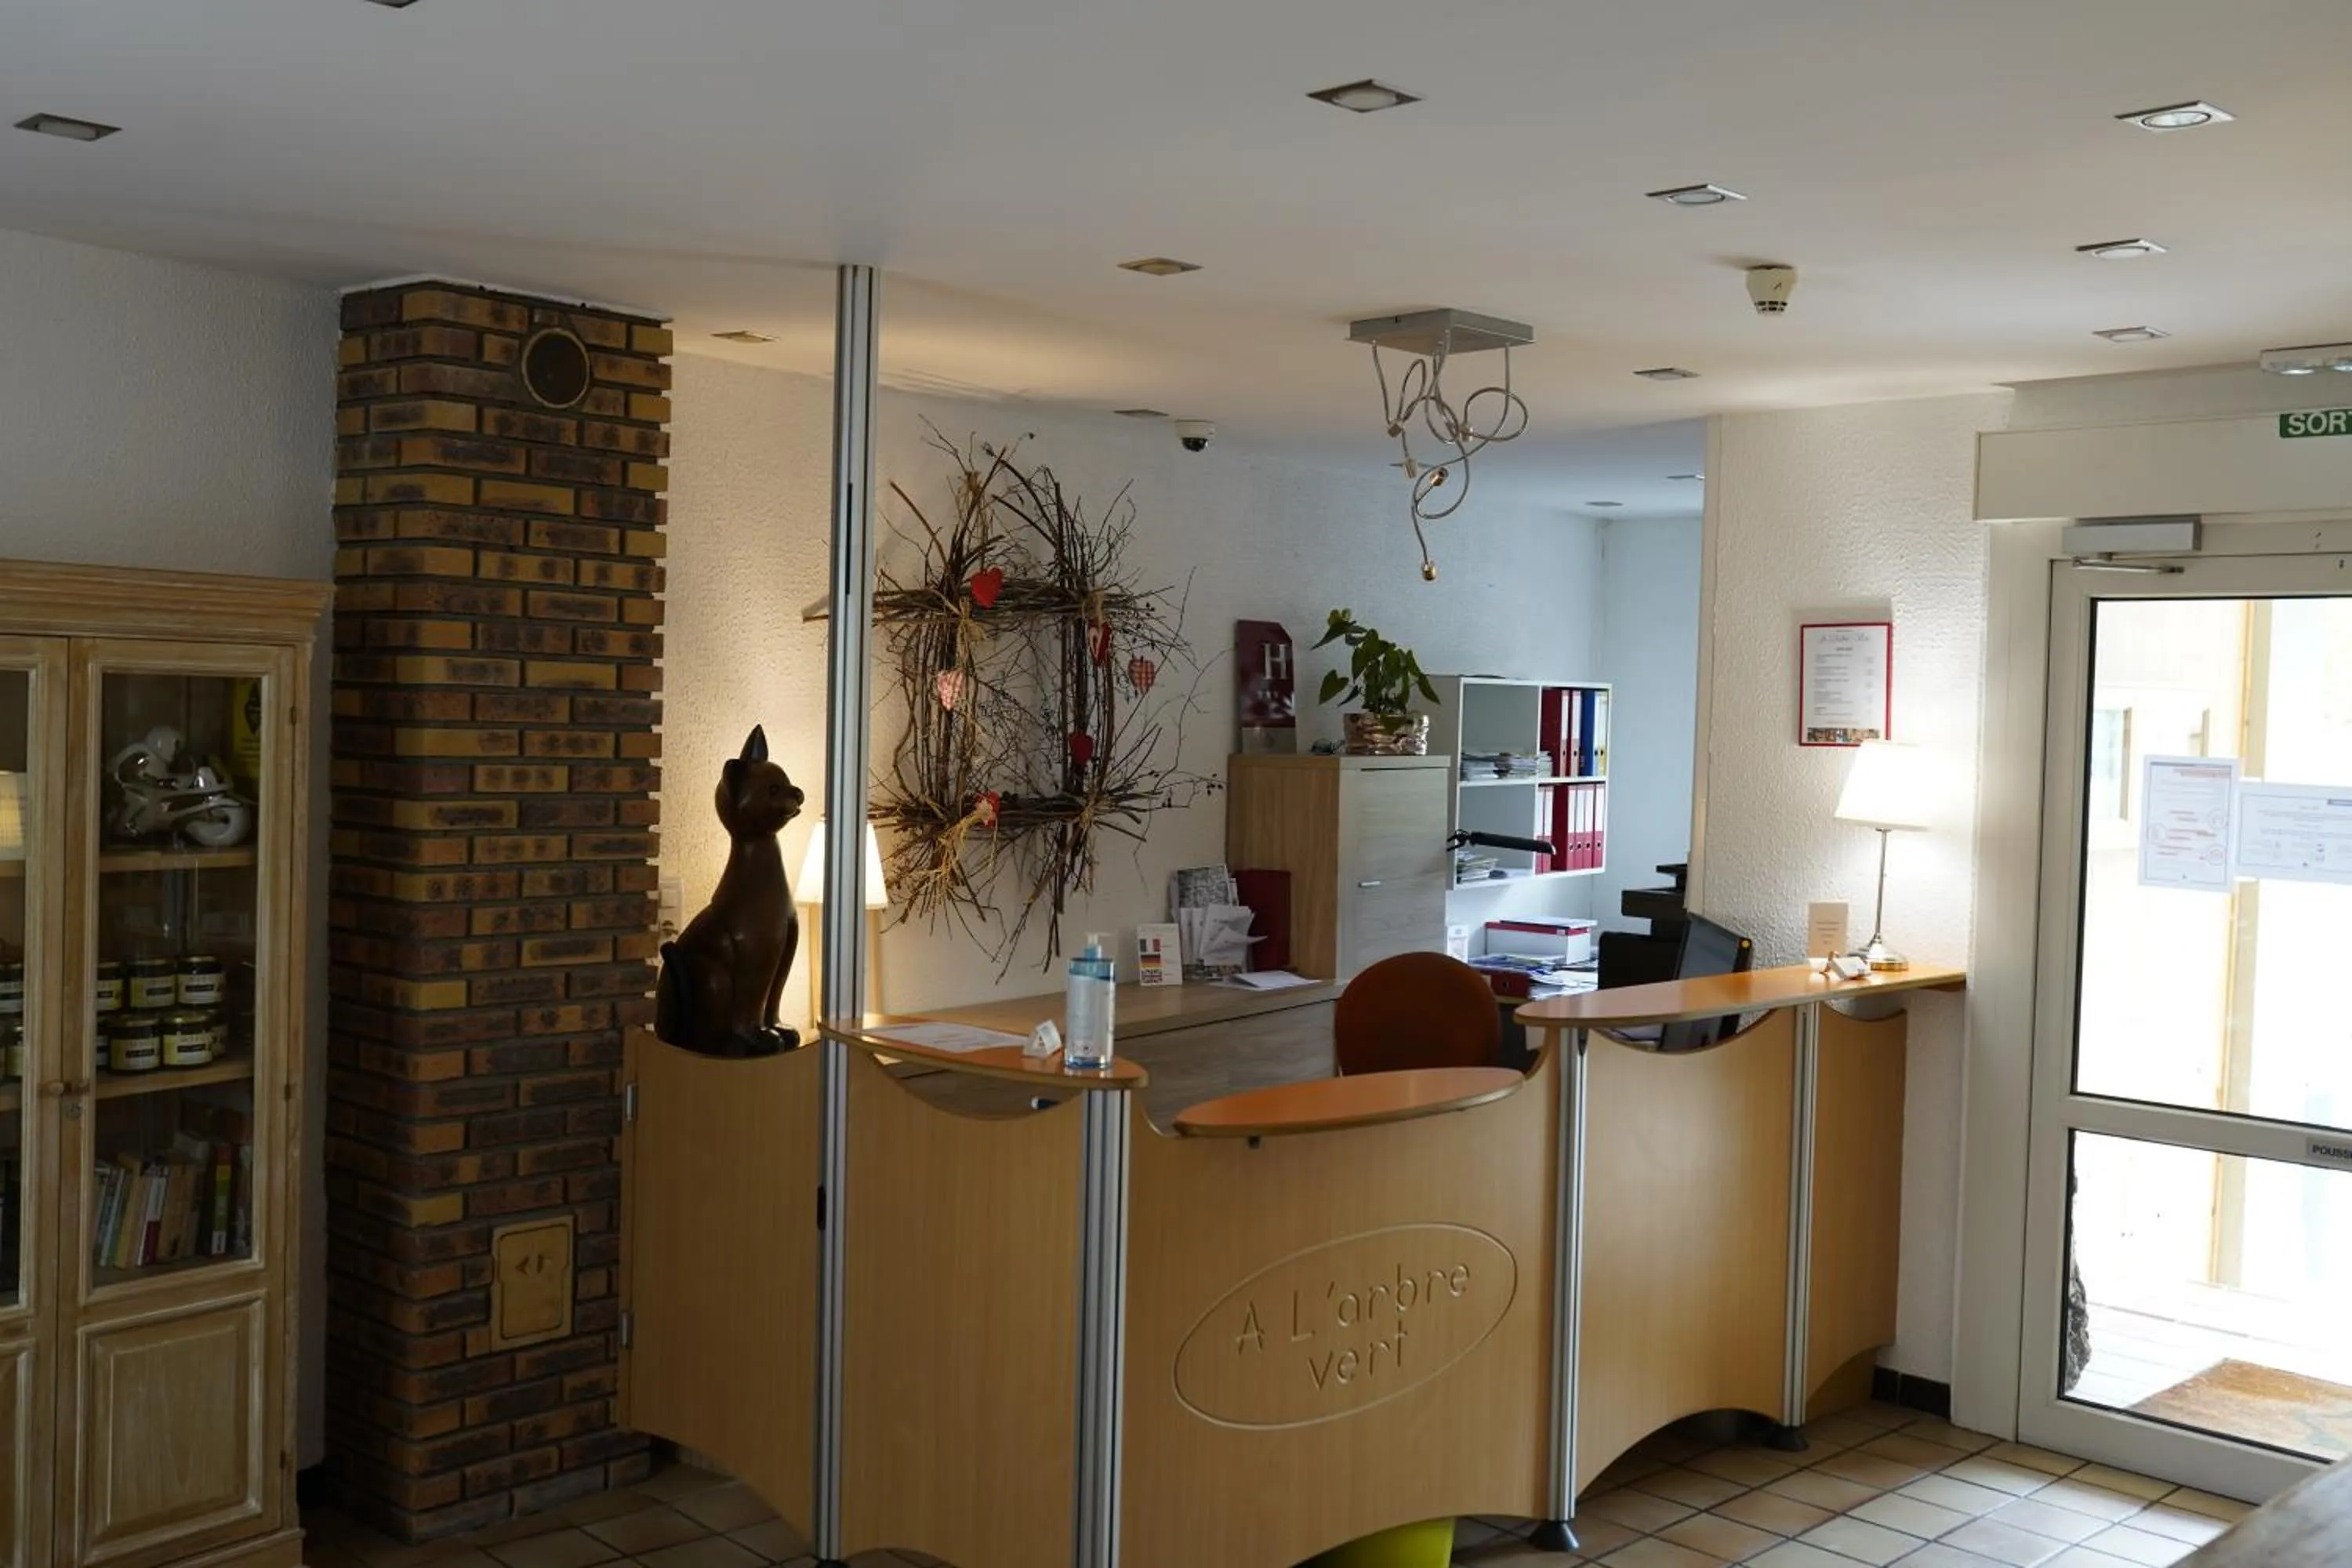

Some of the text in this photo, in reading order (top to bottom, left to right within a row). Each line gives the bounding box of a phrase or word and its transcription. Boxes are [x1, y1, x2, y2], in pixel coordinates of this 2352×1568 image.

[1262, 643, 1287, 680] H
[1236, 1263, 1470, 1355] A L'arbre
[1308, 1319, 1408, 1391] vert
